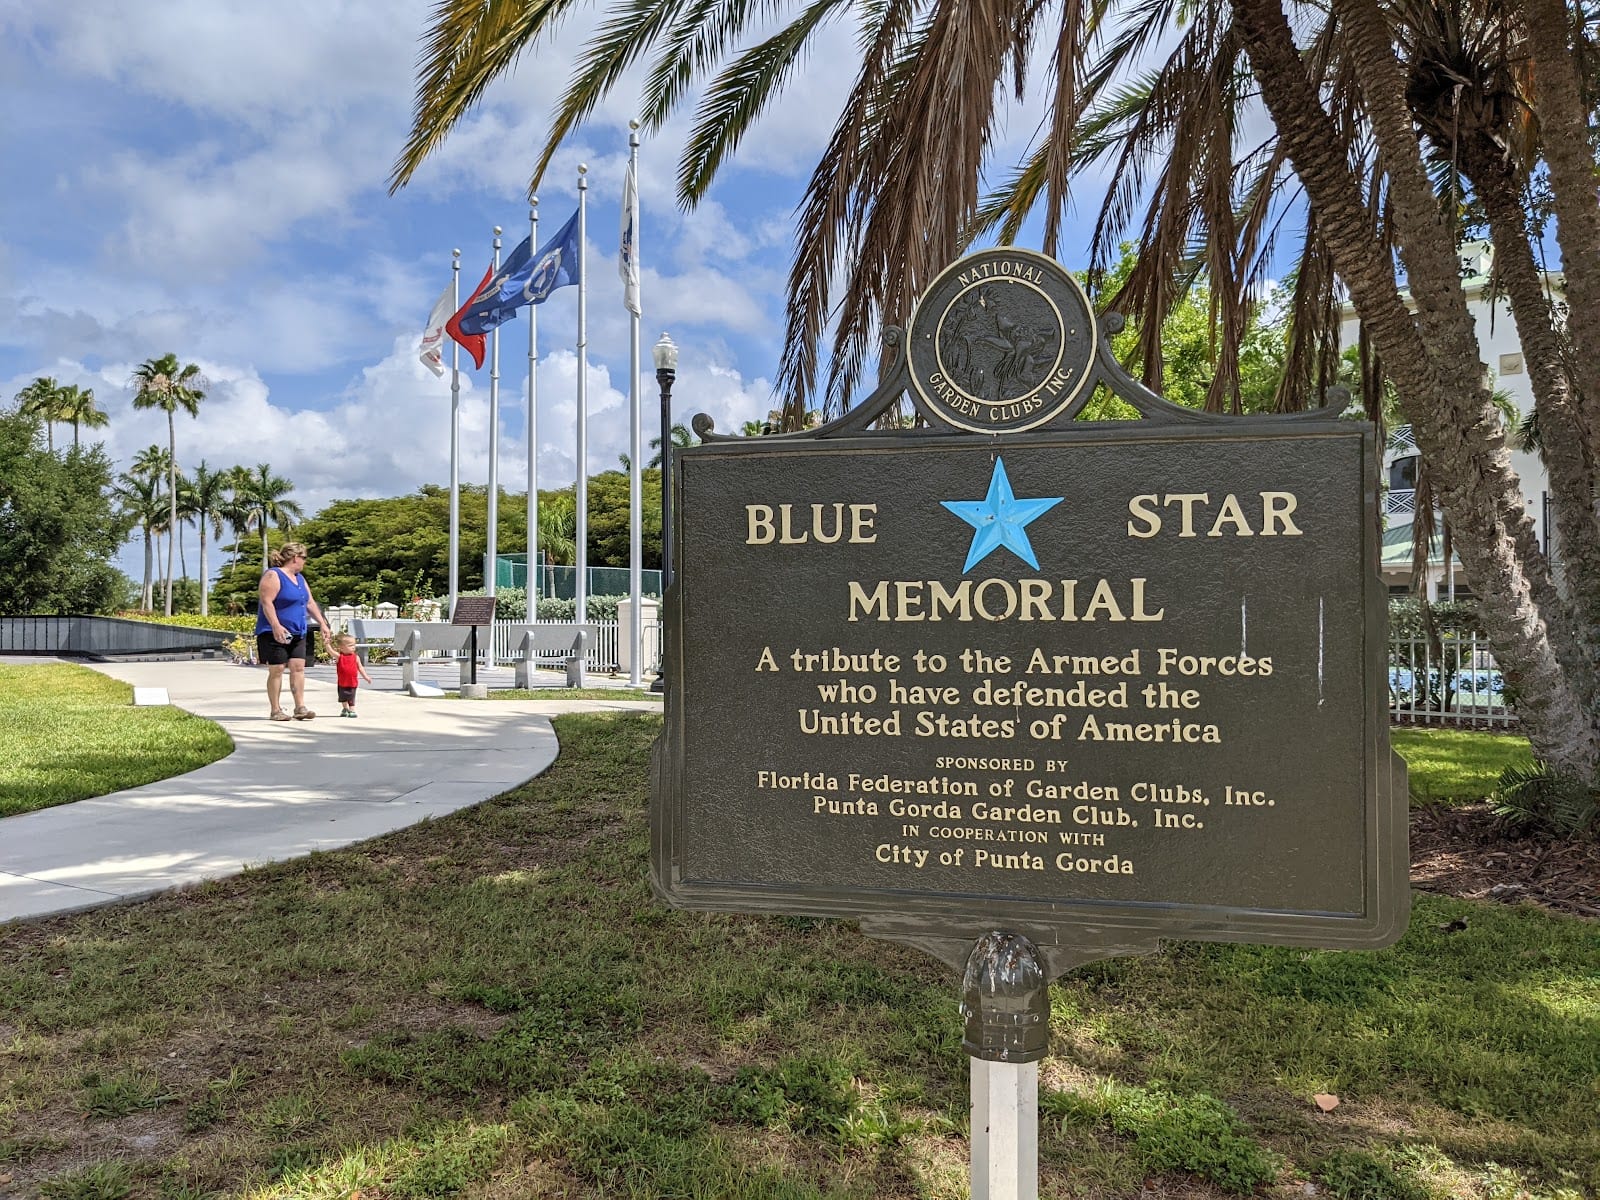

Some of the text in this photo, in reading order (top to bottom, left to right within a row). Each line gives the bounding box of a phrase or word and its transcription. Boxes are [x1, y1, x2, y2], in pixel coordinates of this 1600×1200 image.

[957, 261, 1044, 288] NATIONAL
[929, 367, 1074, 421] GARDEN CLUBS INC.
[745, 491, 1304, 546] BLUE STAR
[847, 577, 1165, 623] MEMORIAL
[754, 646, 1274, 677] A tribute to the Armed Forces
[817, 678, 1201, 709] who have defended the
[798, 708, 1222, 744] United States of America
[935, 756, 1069, 773] SPONSORED BY
[757, 770, 839, 791] Florida
[847, 773, 979, 797] Federation
[988, 778, 1015, 798] of
[1026, 779, 1120, 802] Garden
[1224, 785, 1276, 807] Inc.
[813, 795, 879, 816] Punta
[888, 798, 962, 820] Gorda
[971, 802, 1062, 825] Garden
[1153, 808, 1204, 829] Inc.
[902, 824, 1105, 847] IN COOPERATION WITH
[875, 843, 1135, 875] City of Punta Gorda
